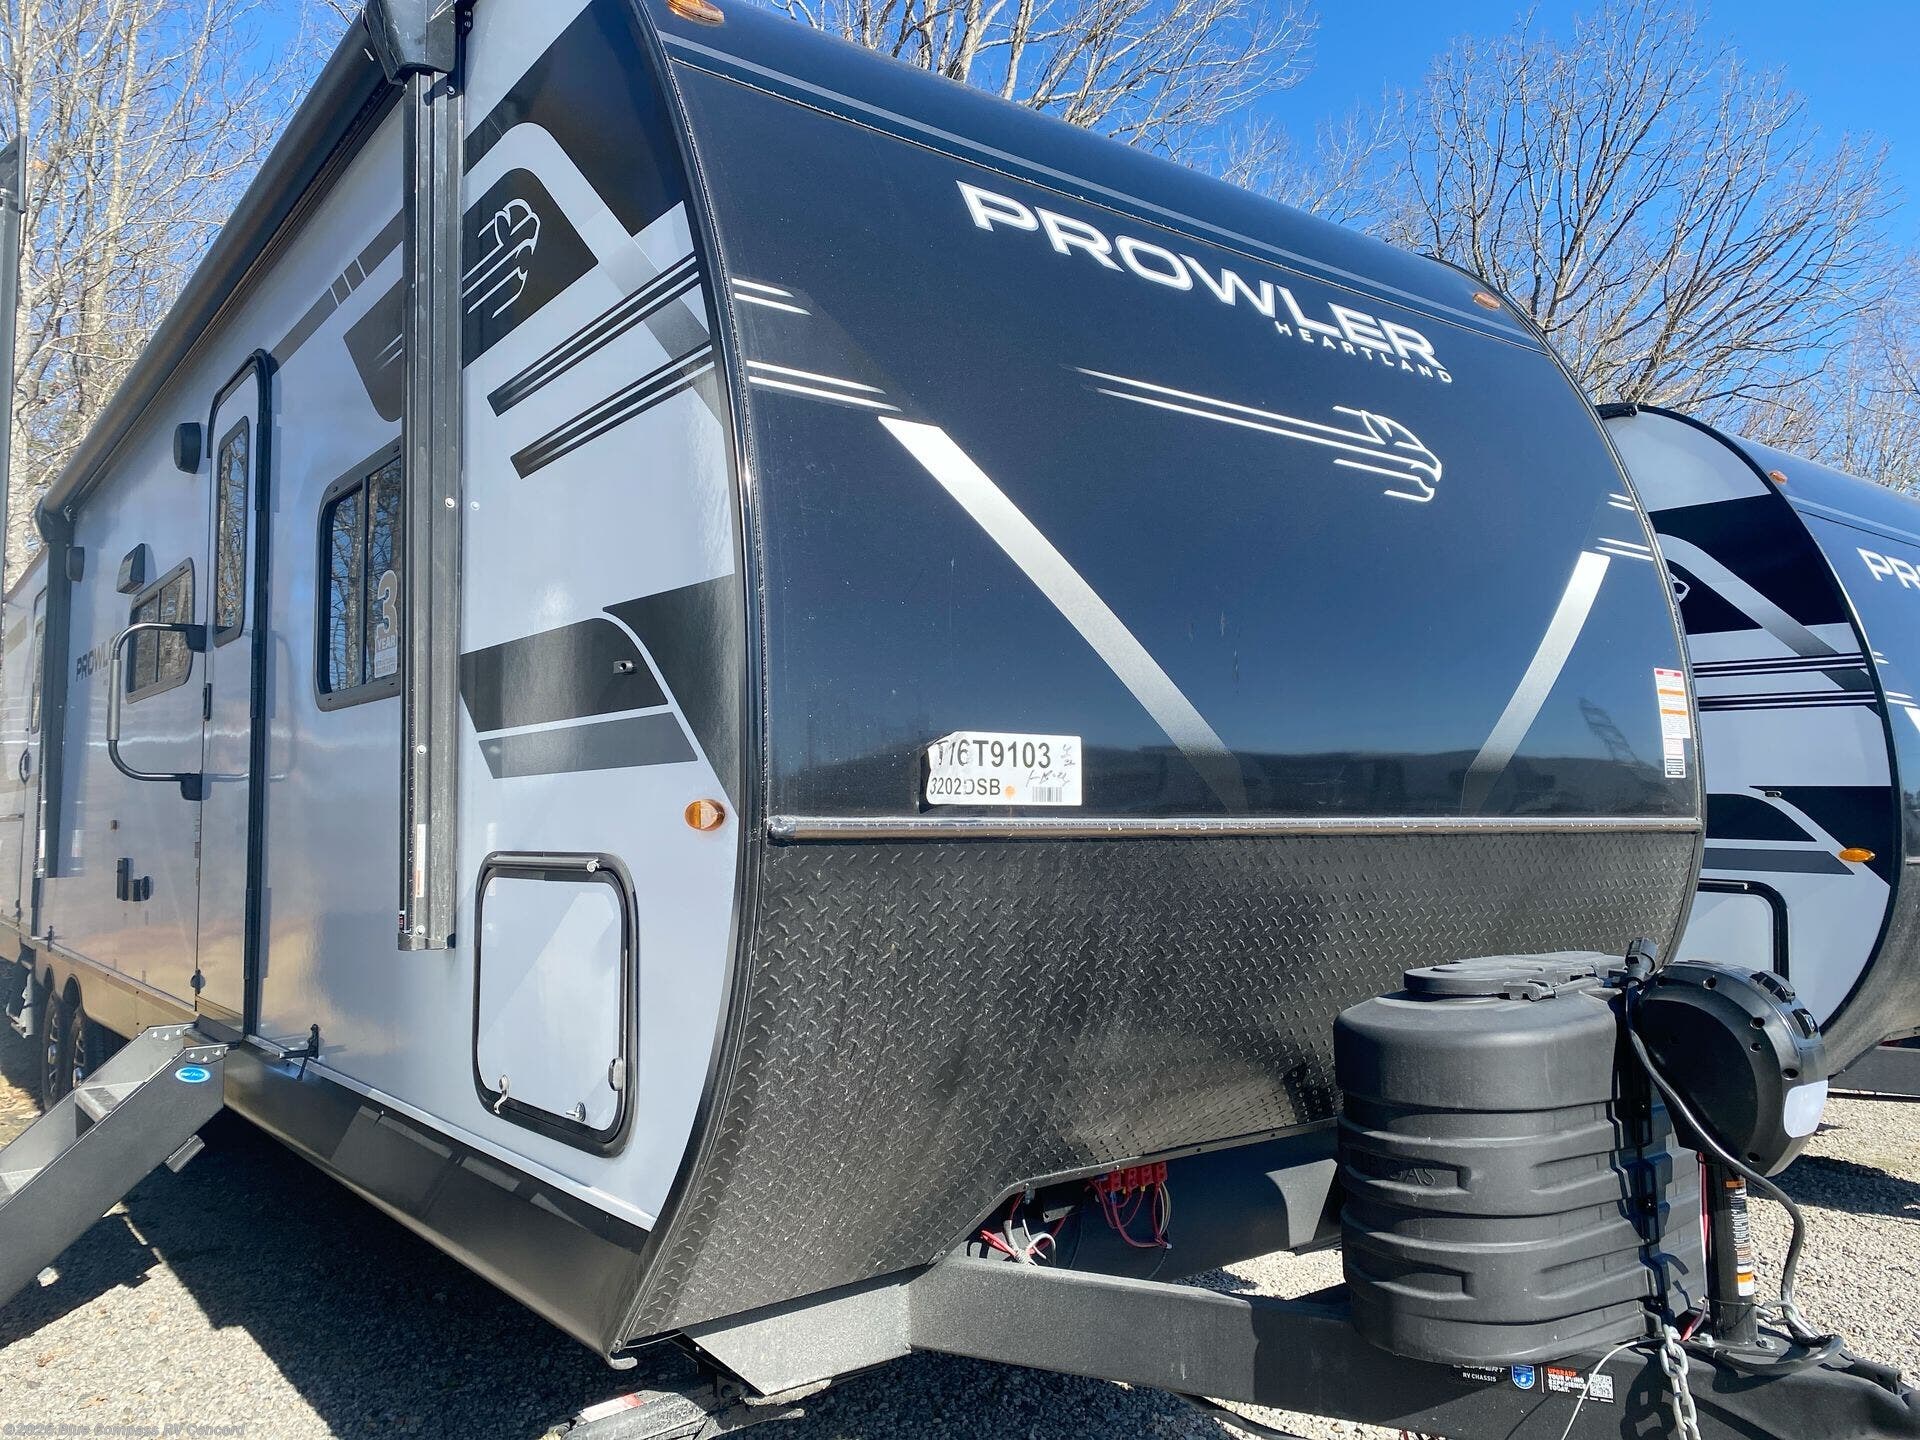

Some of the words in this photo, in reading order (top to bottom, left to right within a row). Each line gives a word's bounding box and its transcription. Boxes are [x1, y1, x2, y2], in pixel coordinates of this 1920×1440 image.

[956, 180, 1448, 370] PROWLER
[1275, 321, 1453, 383] HEARTLAND
[1855, 546, 1920, 590] PR
[376, 635, 396, 651] YEAR
[929, 777, 1001, 795] 3202DSB
[1471, 1373, 1497, 1382] CHASSIS
